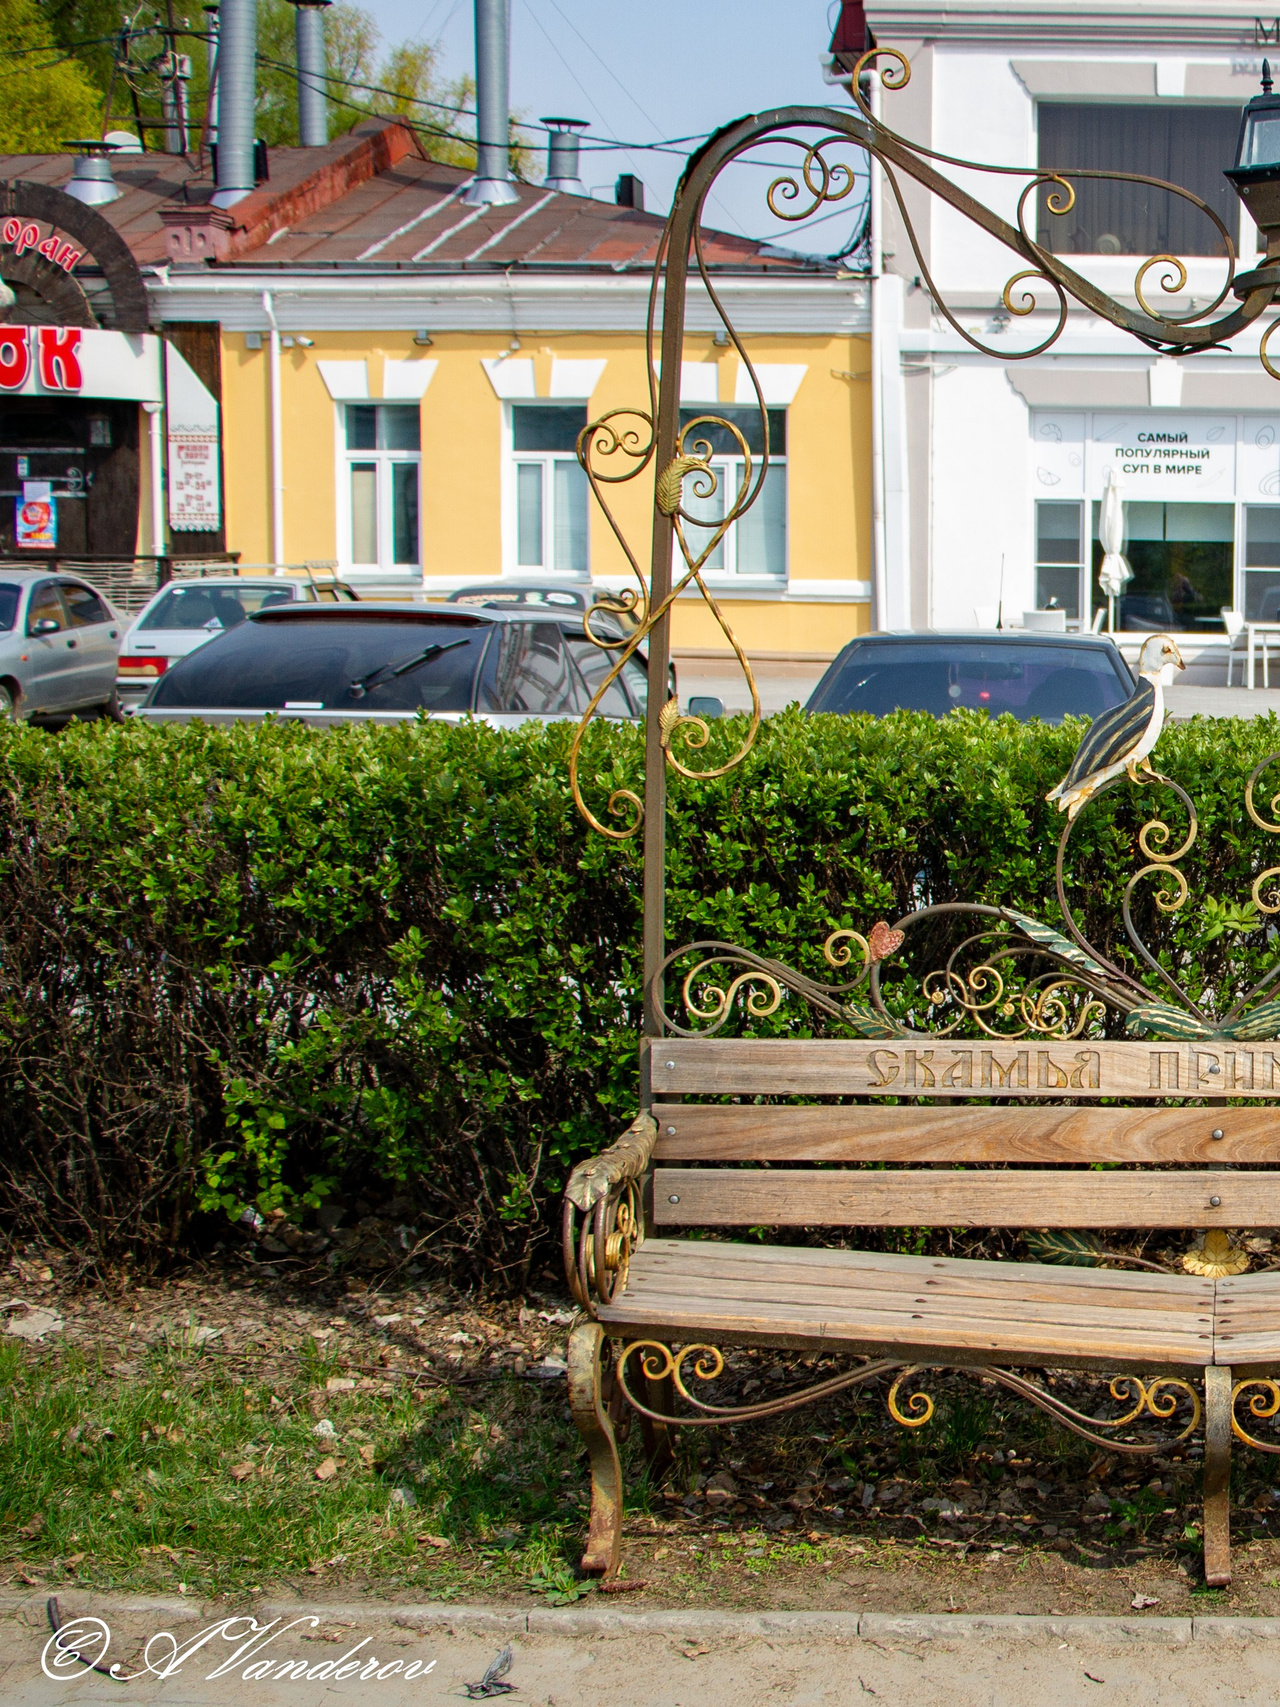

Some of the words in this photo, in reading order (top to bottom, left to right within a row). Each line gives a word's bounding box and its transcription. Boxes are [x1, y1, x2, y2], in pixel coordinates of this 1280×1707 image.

[1137, 432, 1188, 443] САМЫЙ
[1115, 447, 1210, 459] ПОПУЛЯРНЫЙ
[1123, 464, 1149, 473] СУП
[1153, 465, 1161, 473] В
[1166, 465, 1202, 474] МИРЕ
[866, 1049, 1101, 1089] СКАМЬЯ
